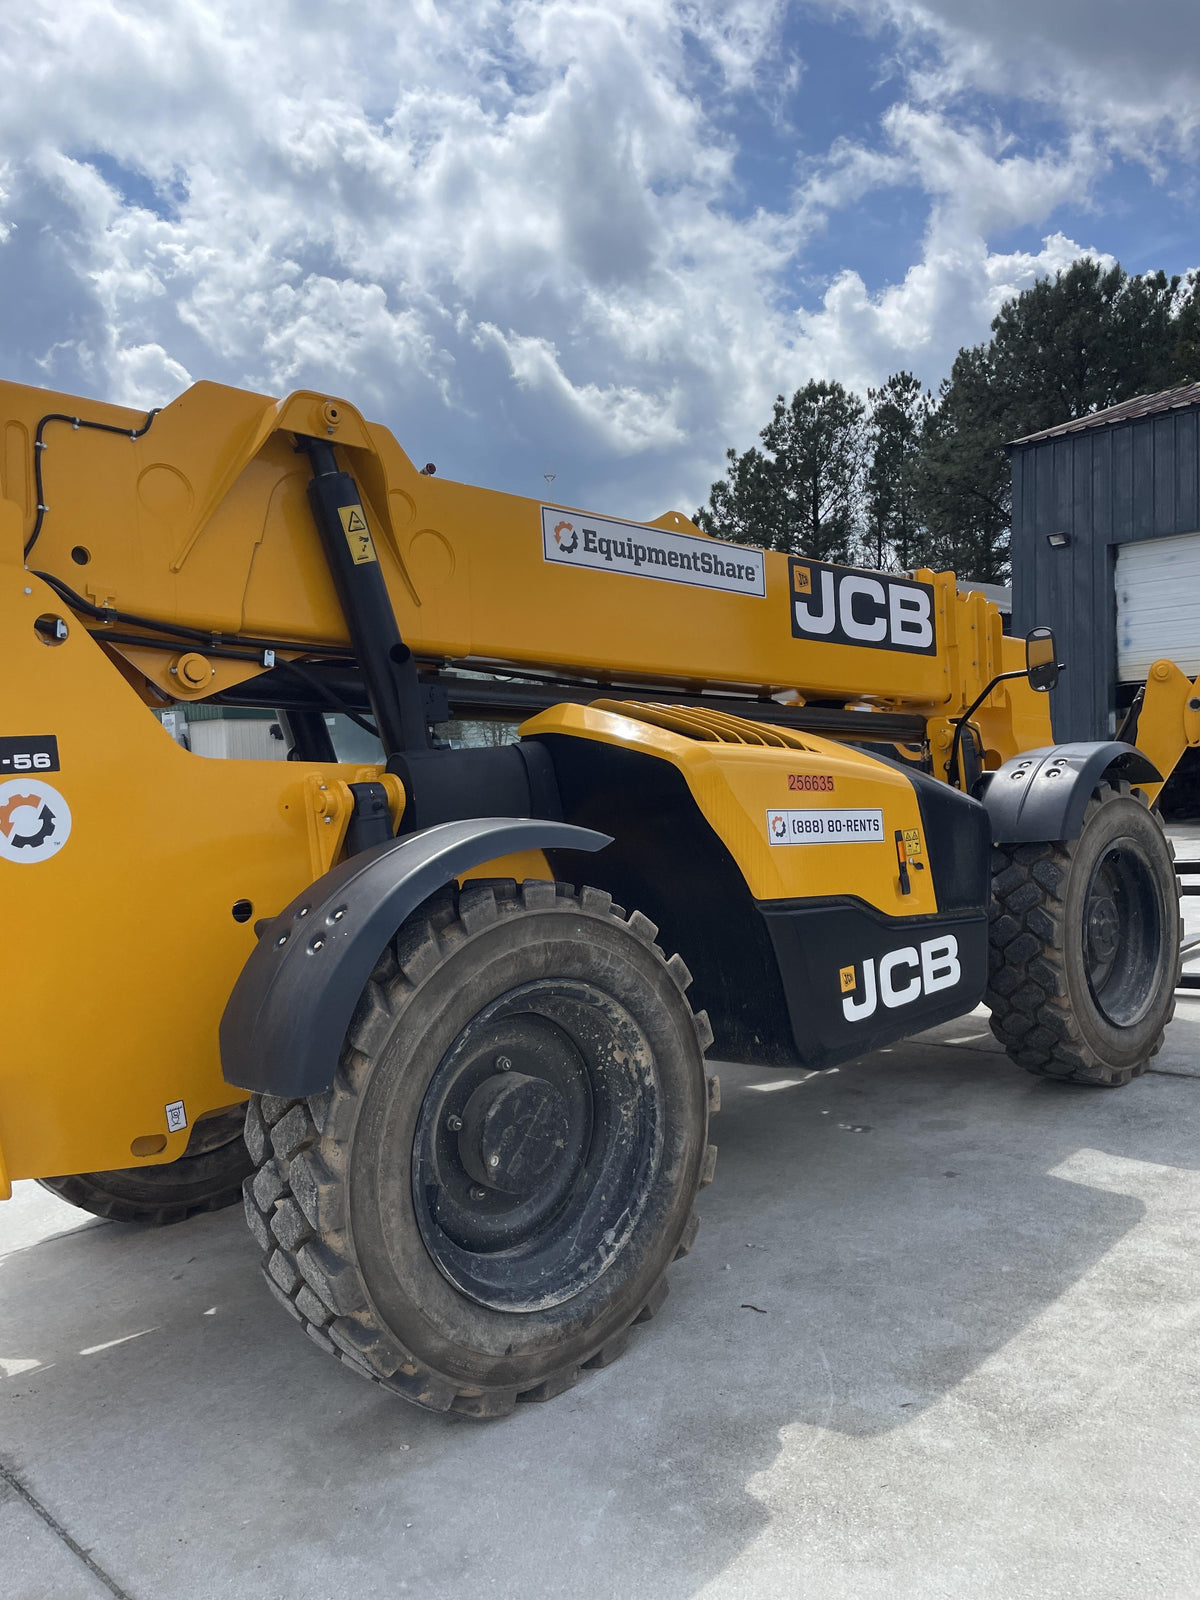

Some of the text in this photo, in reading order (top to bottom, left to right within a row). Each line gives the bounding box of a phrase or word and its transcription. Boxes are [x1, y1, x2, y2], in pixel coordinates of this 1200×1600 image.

[582, 528, 756, 581] EquipmentShare
[795, 570, 933, 648] JCB
[788, 774, 835, 791] 256635
[792, 818, 880, 834] (888) 80-RENTS
[842, 934, 961, 1022] JCB
